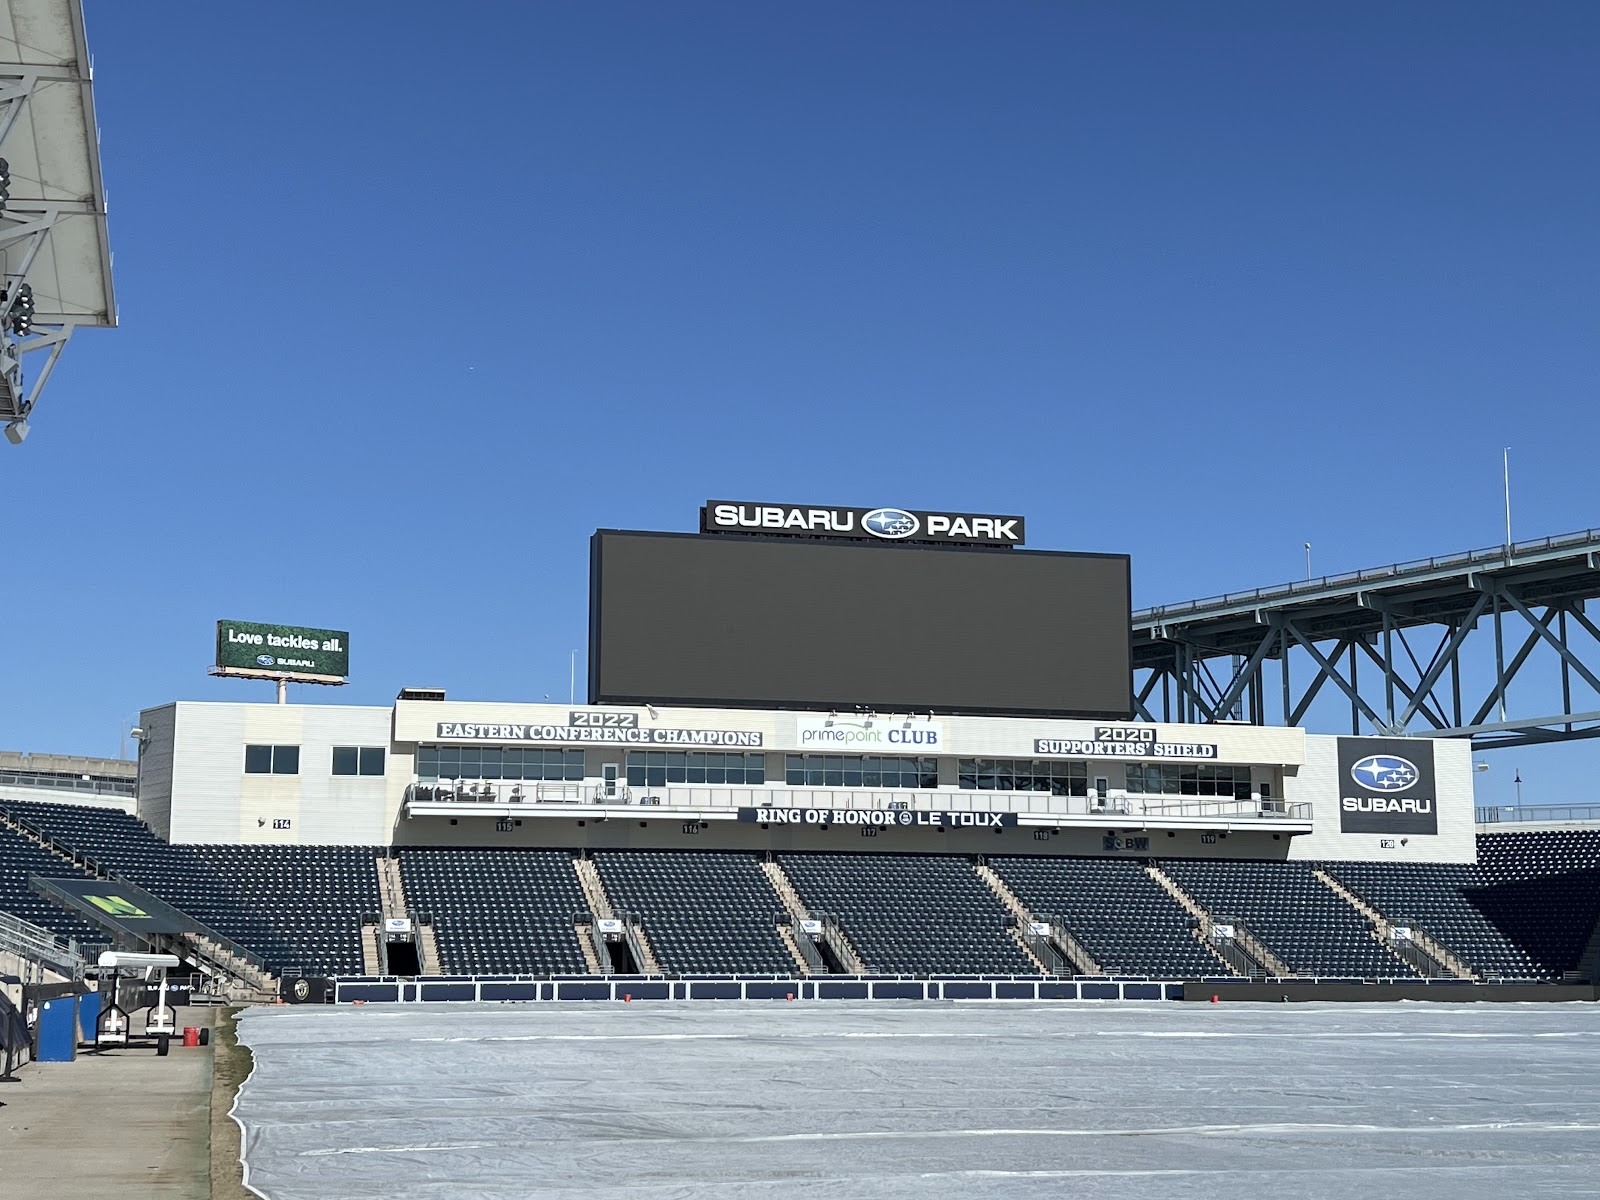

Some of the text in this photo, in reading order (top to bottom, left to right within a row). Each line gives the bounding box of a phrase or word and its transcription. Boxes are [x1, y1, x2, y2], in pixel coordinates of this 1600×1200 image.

[714, 504, 1019, 540] SUBARU PARK
[228, 629, 343, 652] Love tackles all.
[277, 658, 315, 667] SUBARU
[572, 712, 635, 727] 2022
[440, 723, 762, 746] EASTERN CONFERENCE CHAMPIONS
[802, 728, 938, 746] primepoint CLUB
[1098, 728, 1153, 742] 2020
[1038, 740, 1214, 758] SUPPORTERS' SHIELD
[1342, 797, 1431, 814] SUBARU
[273, 819, 290, 829] 114
[755, 808, 1004, 827] RING OF HONOR LE TOUX
[1381, 840, 1394, 848] 120
